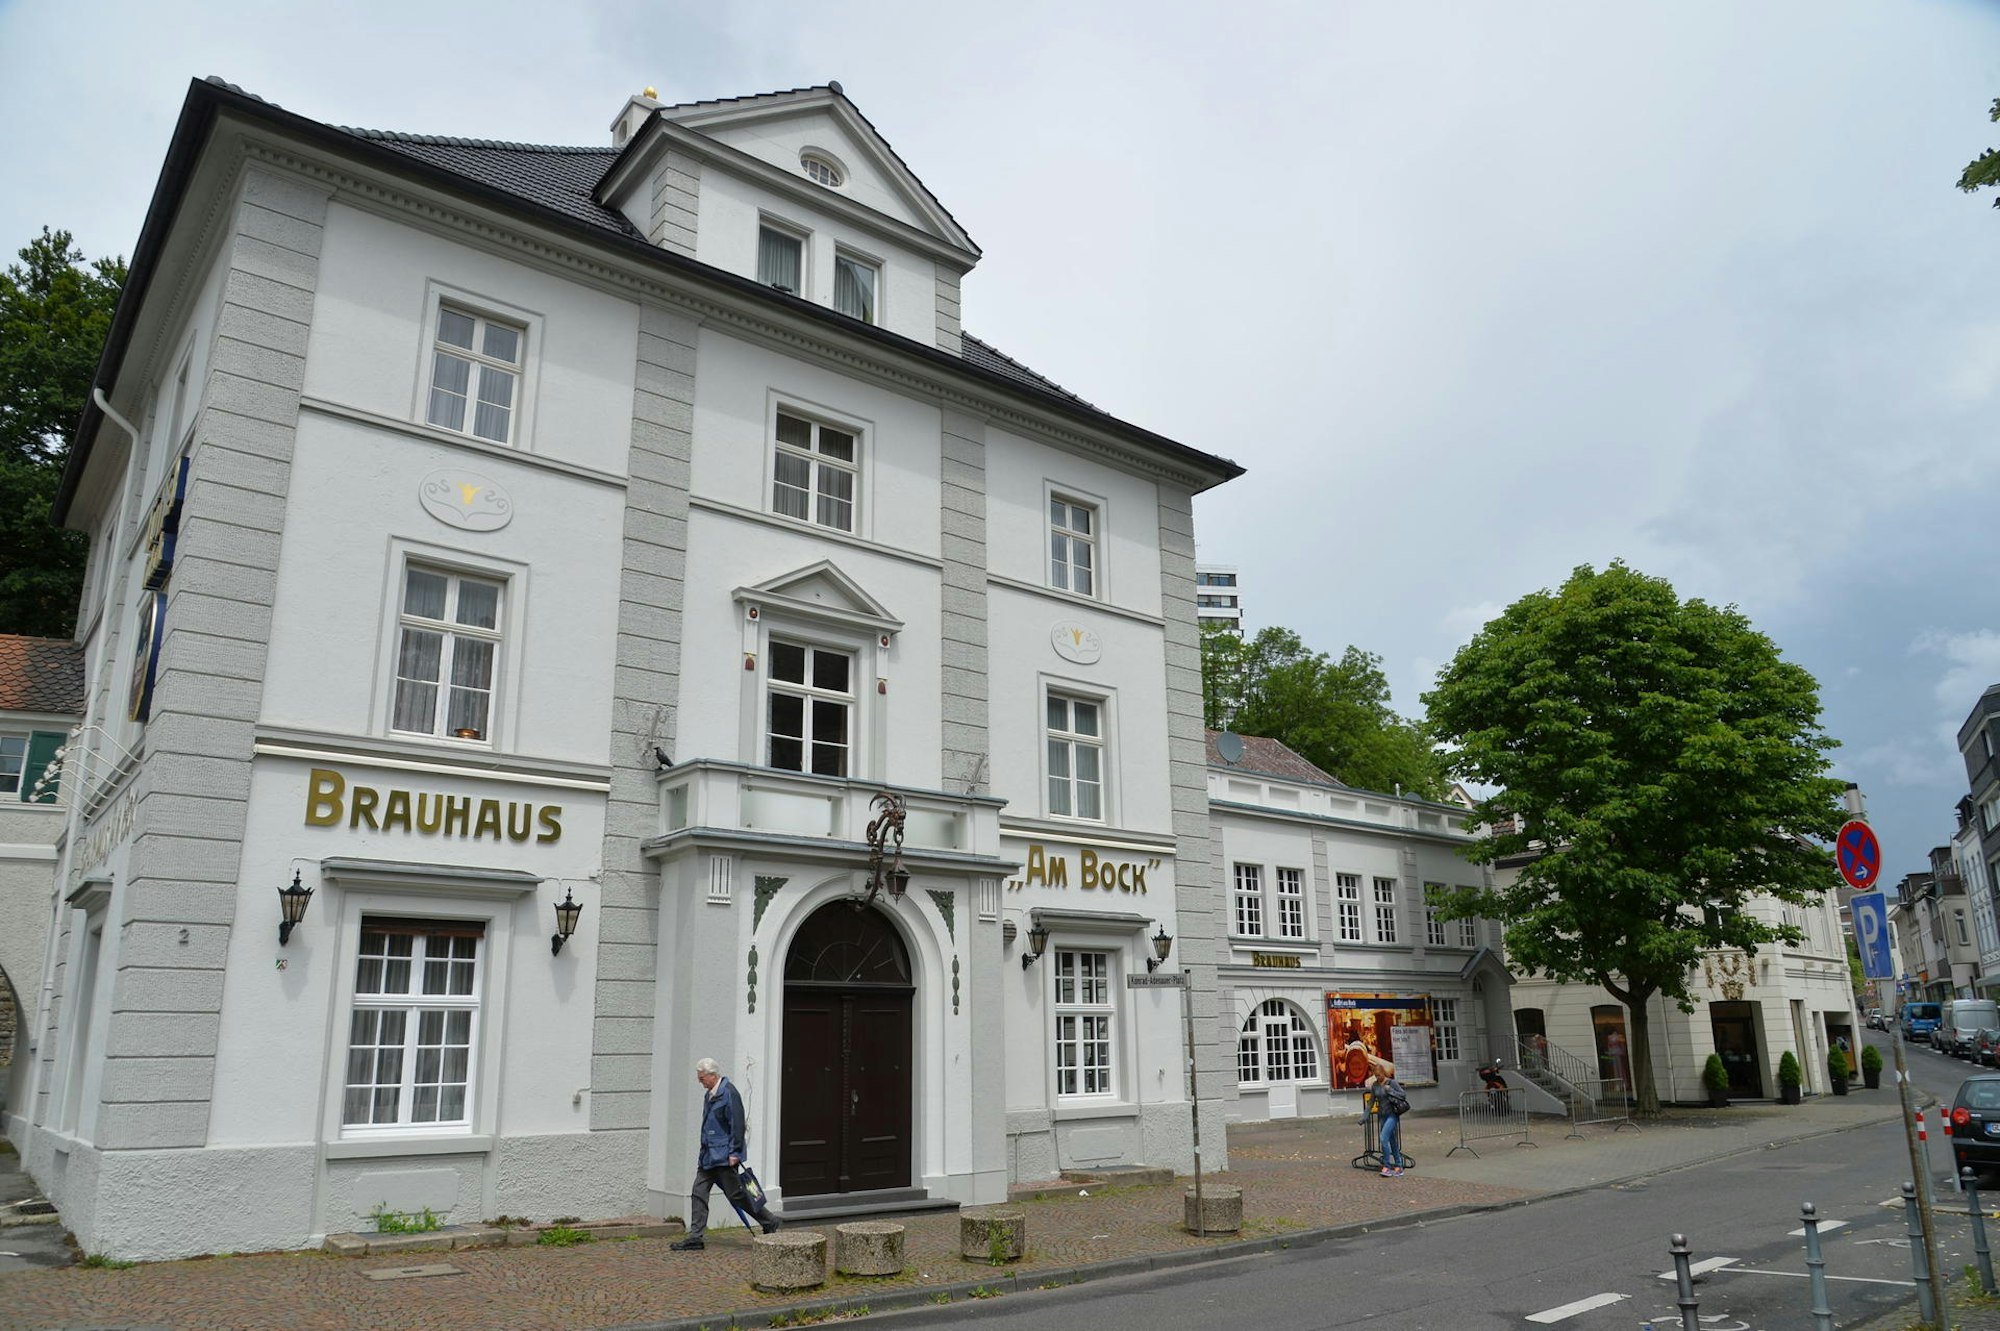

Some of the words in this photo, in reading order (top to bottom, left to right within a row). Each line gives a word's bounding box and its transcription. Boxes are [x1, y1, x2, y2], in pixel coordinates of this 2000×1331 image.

[305, 768, 562, 843] BRAUHAUS
[179, 929, 190, 944] 2
[1858, 905, 1879, 968] P
[1252, 951, 1301, 968] BRAUHAUS
